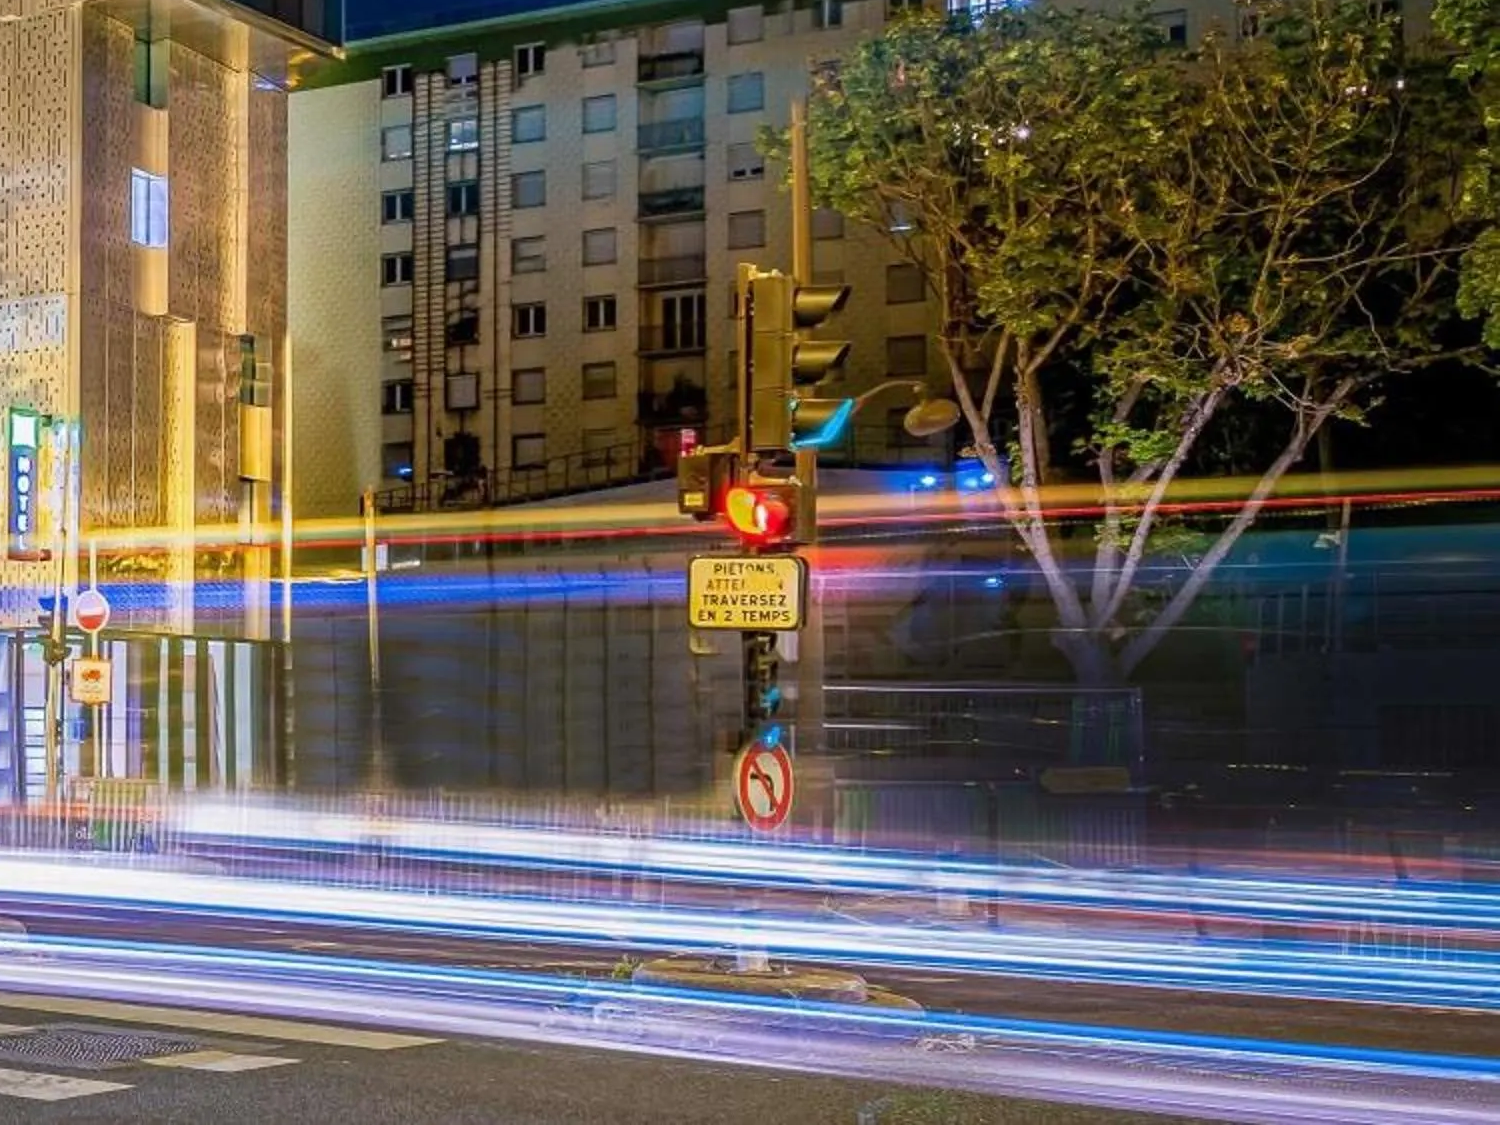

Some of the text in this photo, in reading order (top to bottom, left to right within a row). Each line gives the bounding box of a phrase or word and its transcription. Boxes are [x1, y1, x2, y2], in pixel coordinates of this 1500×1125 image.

[17, 456, 31, 550] HOTEL
[702, 594, 787, 607] TRAVERSEZ
[698, 610, 790, 622] EN 2 TEMPS
